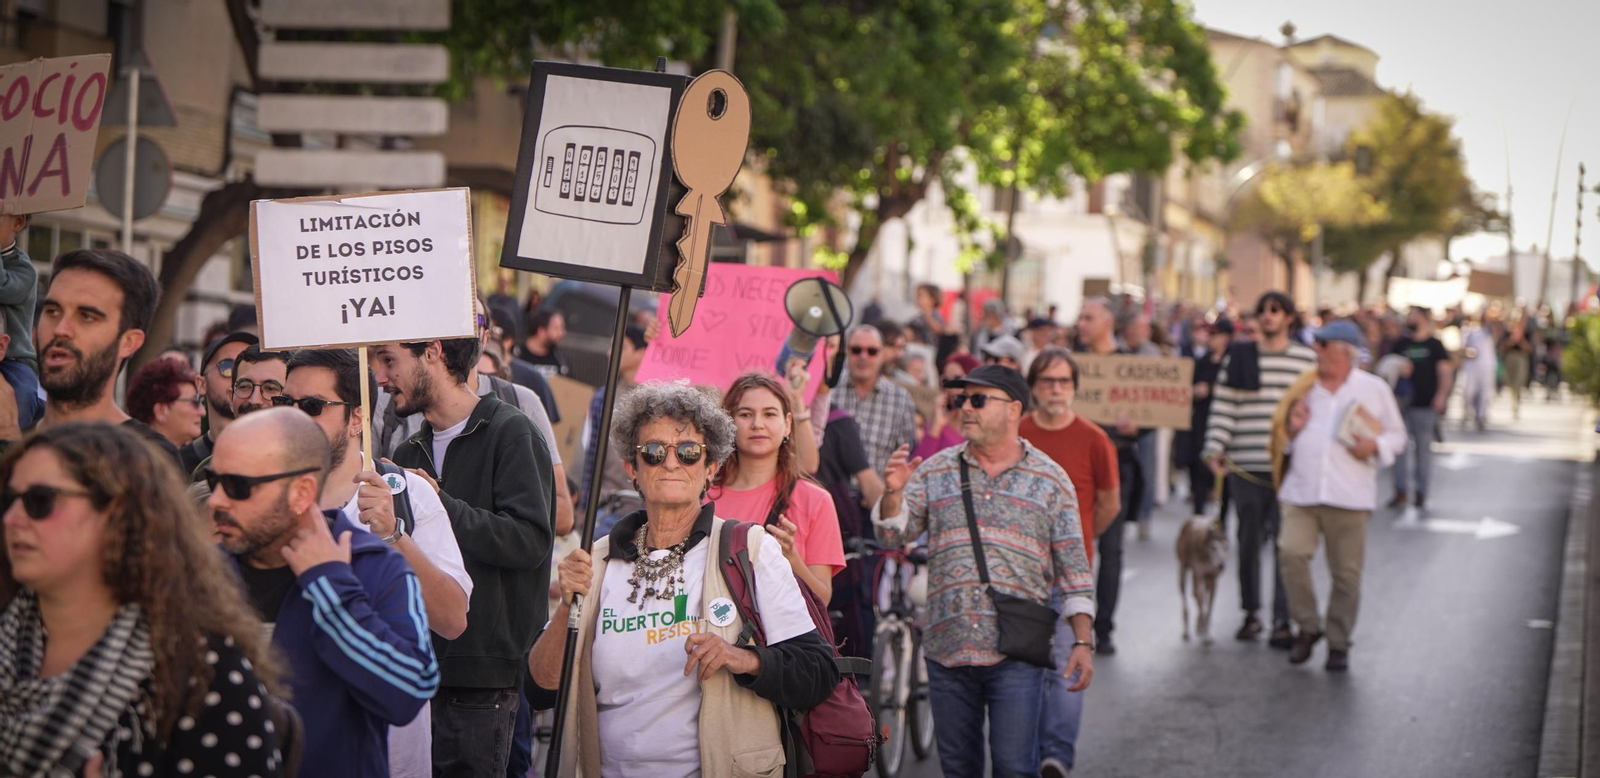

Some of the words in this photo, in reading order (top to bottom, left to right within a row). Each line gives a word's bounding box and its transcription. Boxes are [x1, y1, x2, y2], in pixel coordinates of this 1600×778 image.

[0, 62, 106, 132] OCIO
[300, 209, 421, 232] LIMITACIÓN
[296, 245, 321, 260] DE
[328, 242, 366, 258] LOS
[372, 238, 434, 255] PISOS
[302, 265, 424, 287] TURÍSTICOS
[341, 295, 396, 324] ¡YA!
[651, 342, 713, 371] DONDE
[1108, 385, 1190, 407] BASTARDS
[602, 611, 675, 635] PUERTO
[603, 608, 617, 618] EL
